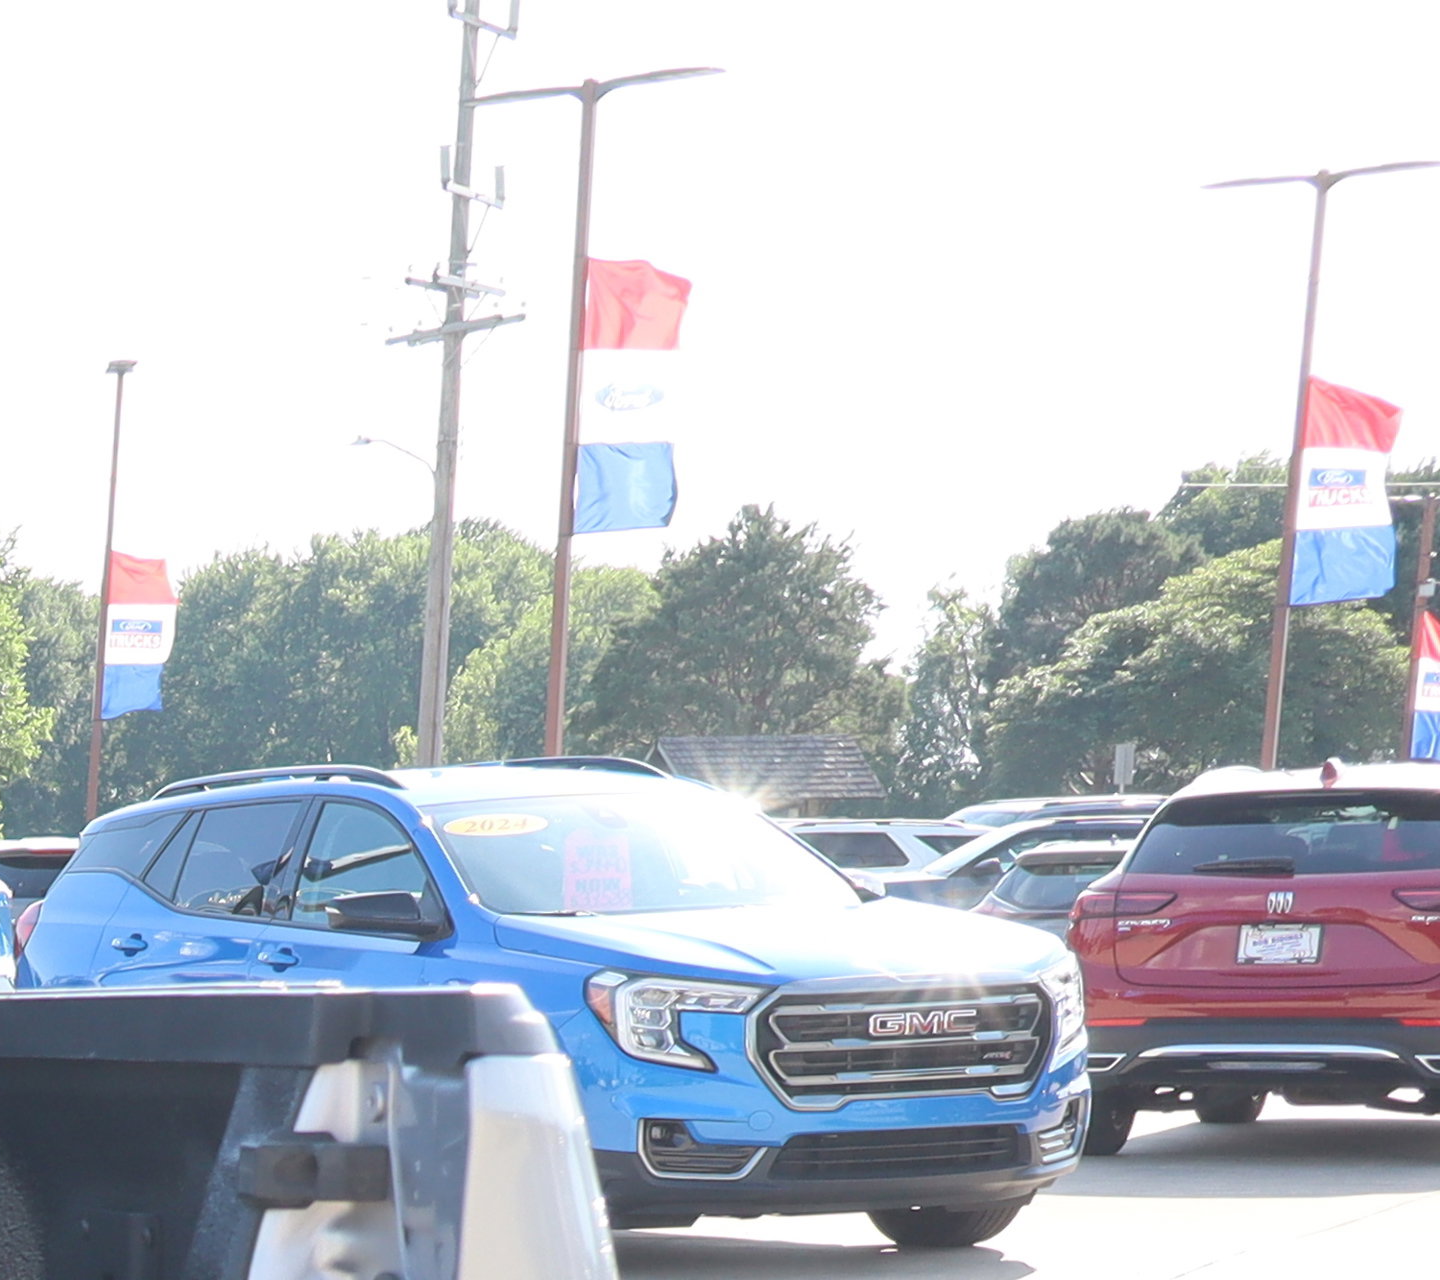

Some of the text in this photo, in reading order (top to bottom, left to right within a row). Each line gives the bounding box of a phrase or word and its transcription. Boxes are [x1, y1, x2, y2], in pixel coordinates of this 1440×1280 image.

[110, 633, 162, 649] TRUCKS
[464, 818, 529, 833] 2024
[869, 1009, 977, 1037] GMC
